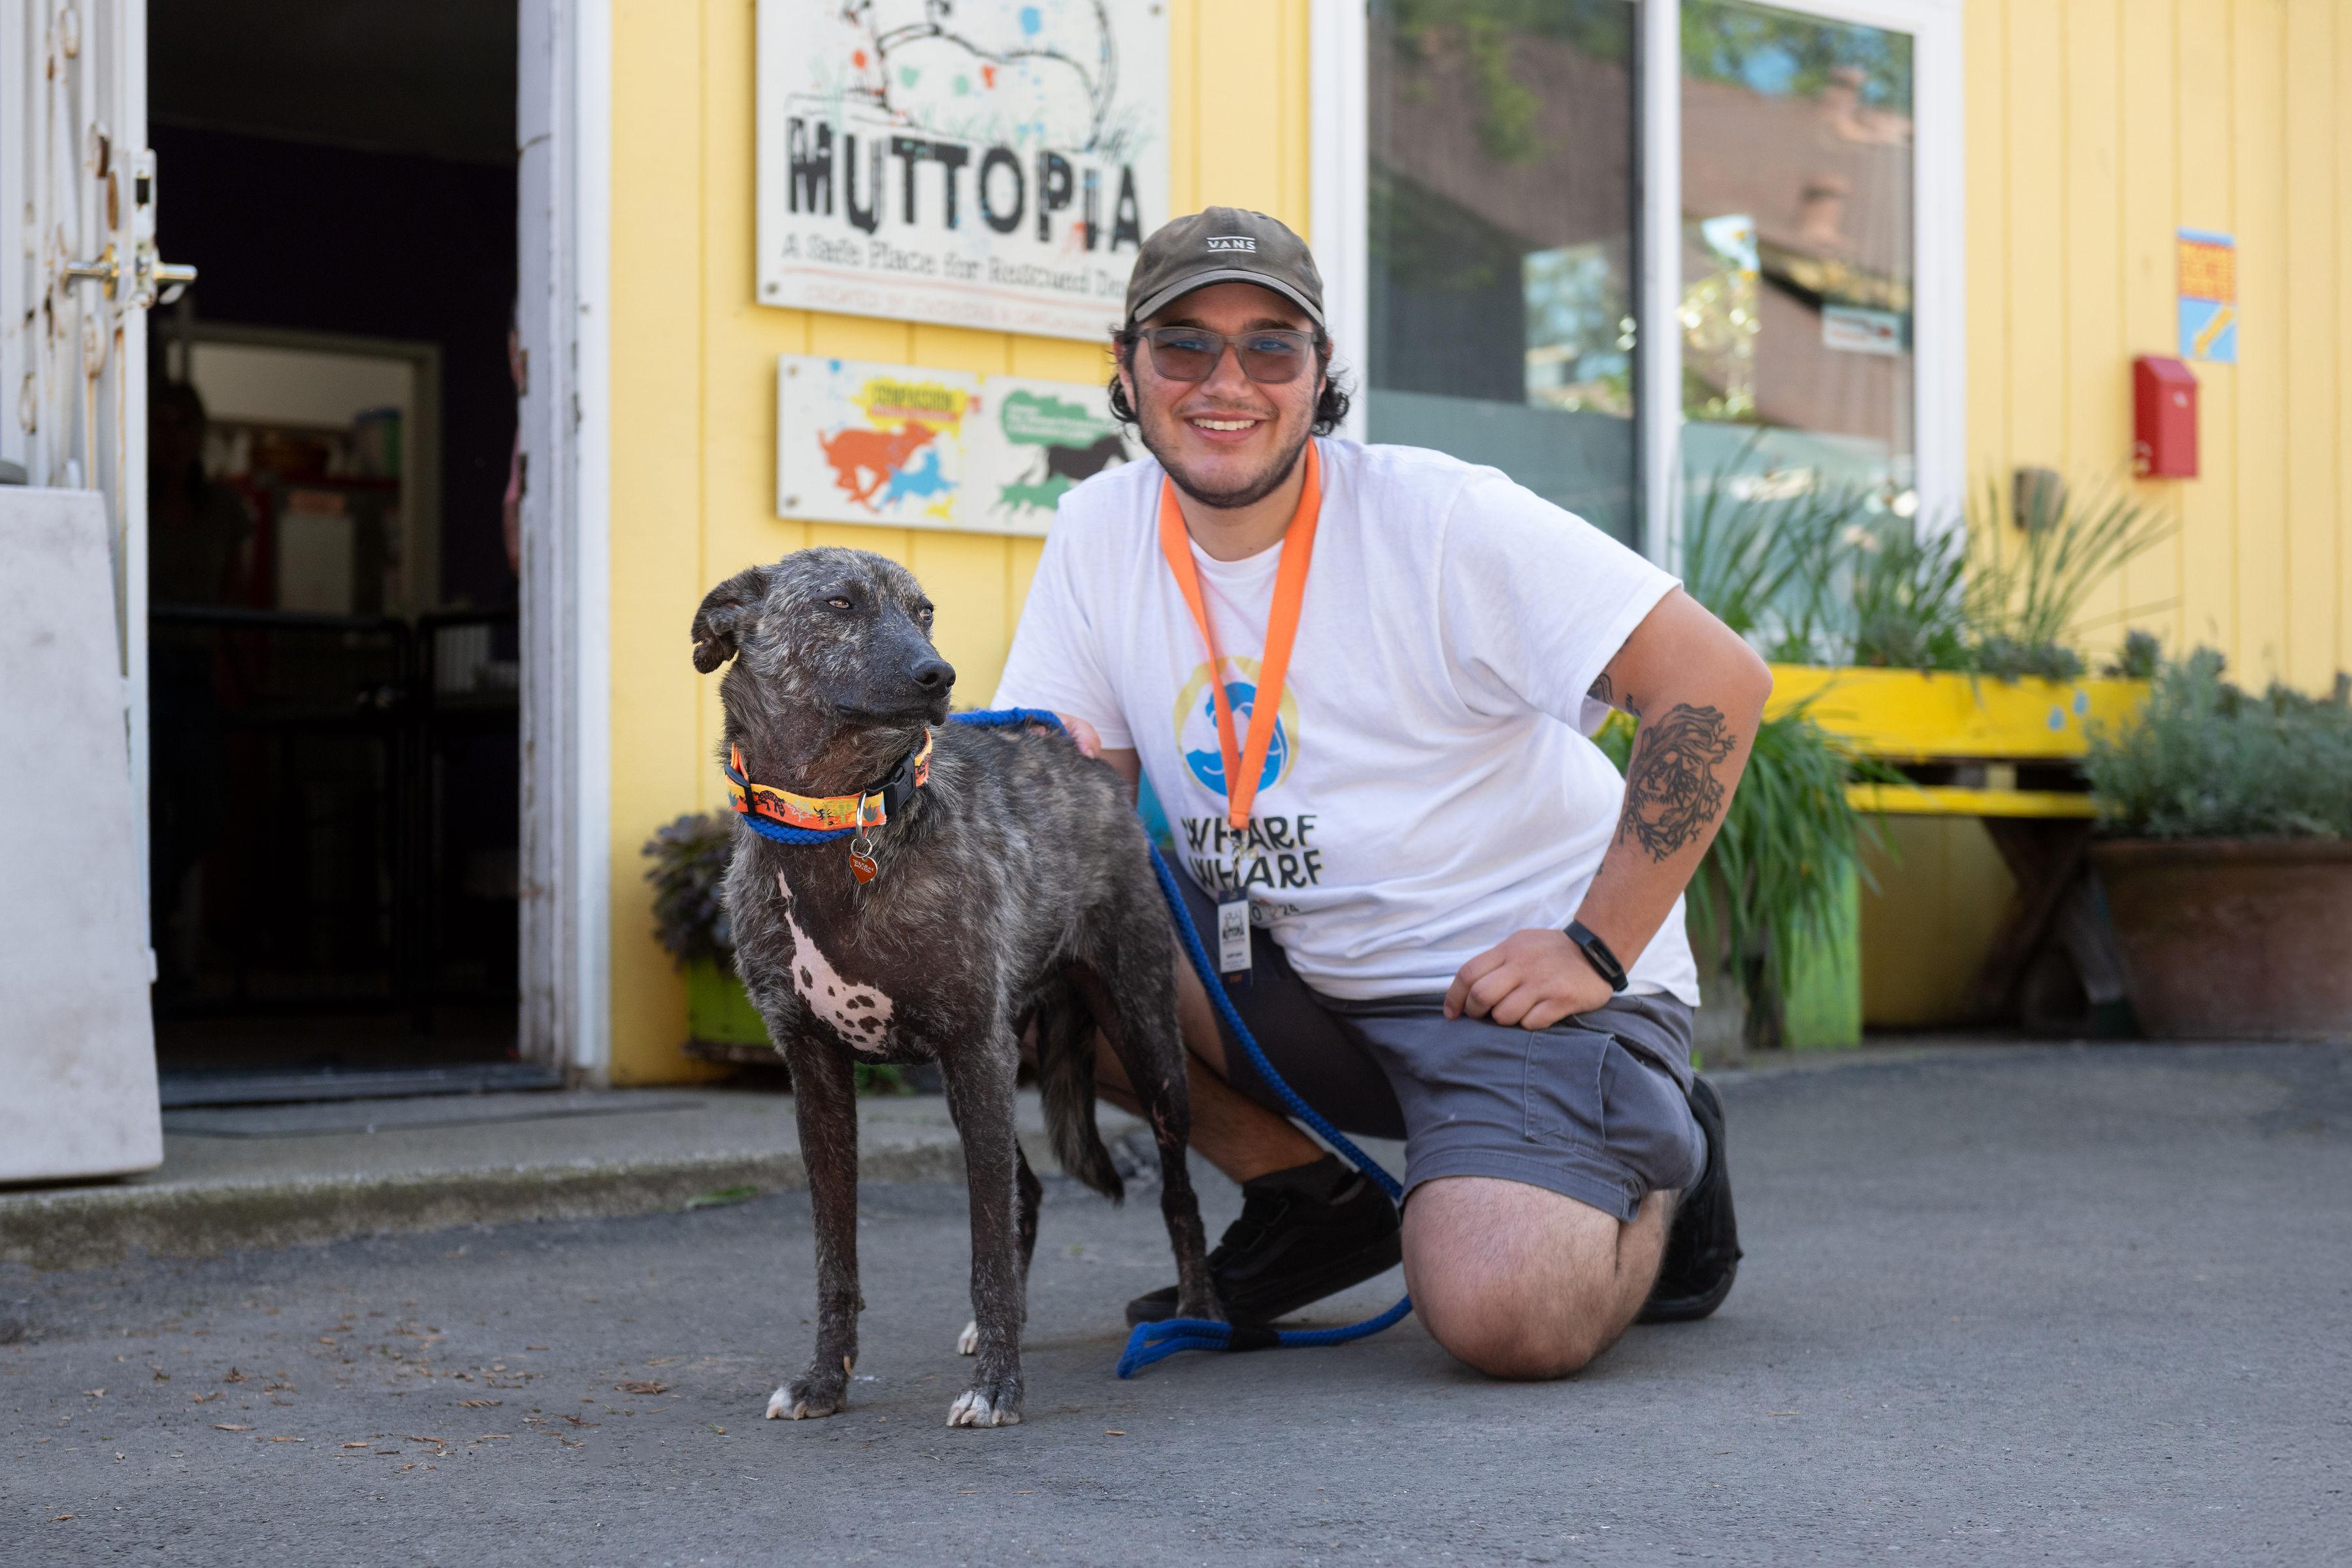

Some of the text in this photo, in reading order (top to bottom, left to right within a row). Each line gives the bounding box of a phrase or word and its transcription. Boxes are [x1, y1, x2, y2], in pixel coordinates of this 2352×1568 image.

[787, 117, 1142, 252] MUTTOPIA
[781, 232, 1128, 297] A Safe Place for Rescued Do
[1207, 239, 1256, 250] VANS
[1181, 815, 1317, 853] WHARF
[1189, 849, 1322, 889] WHARF
